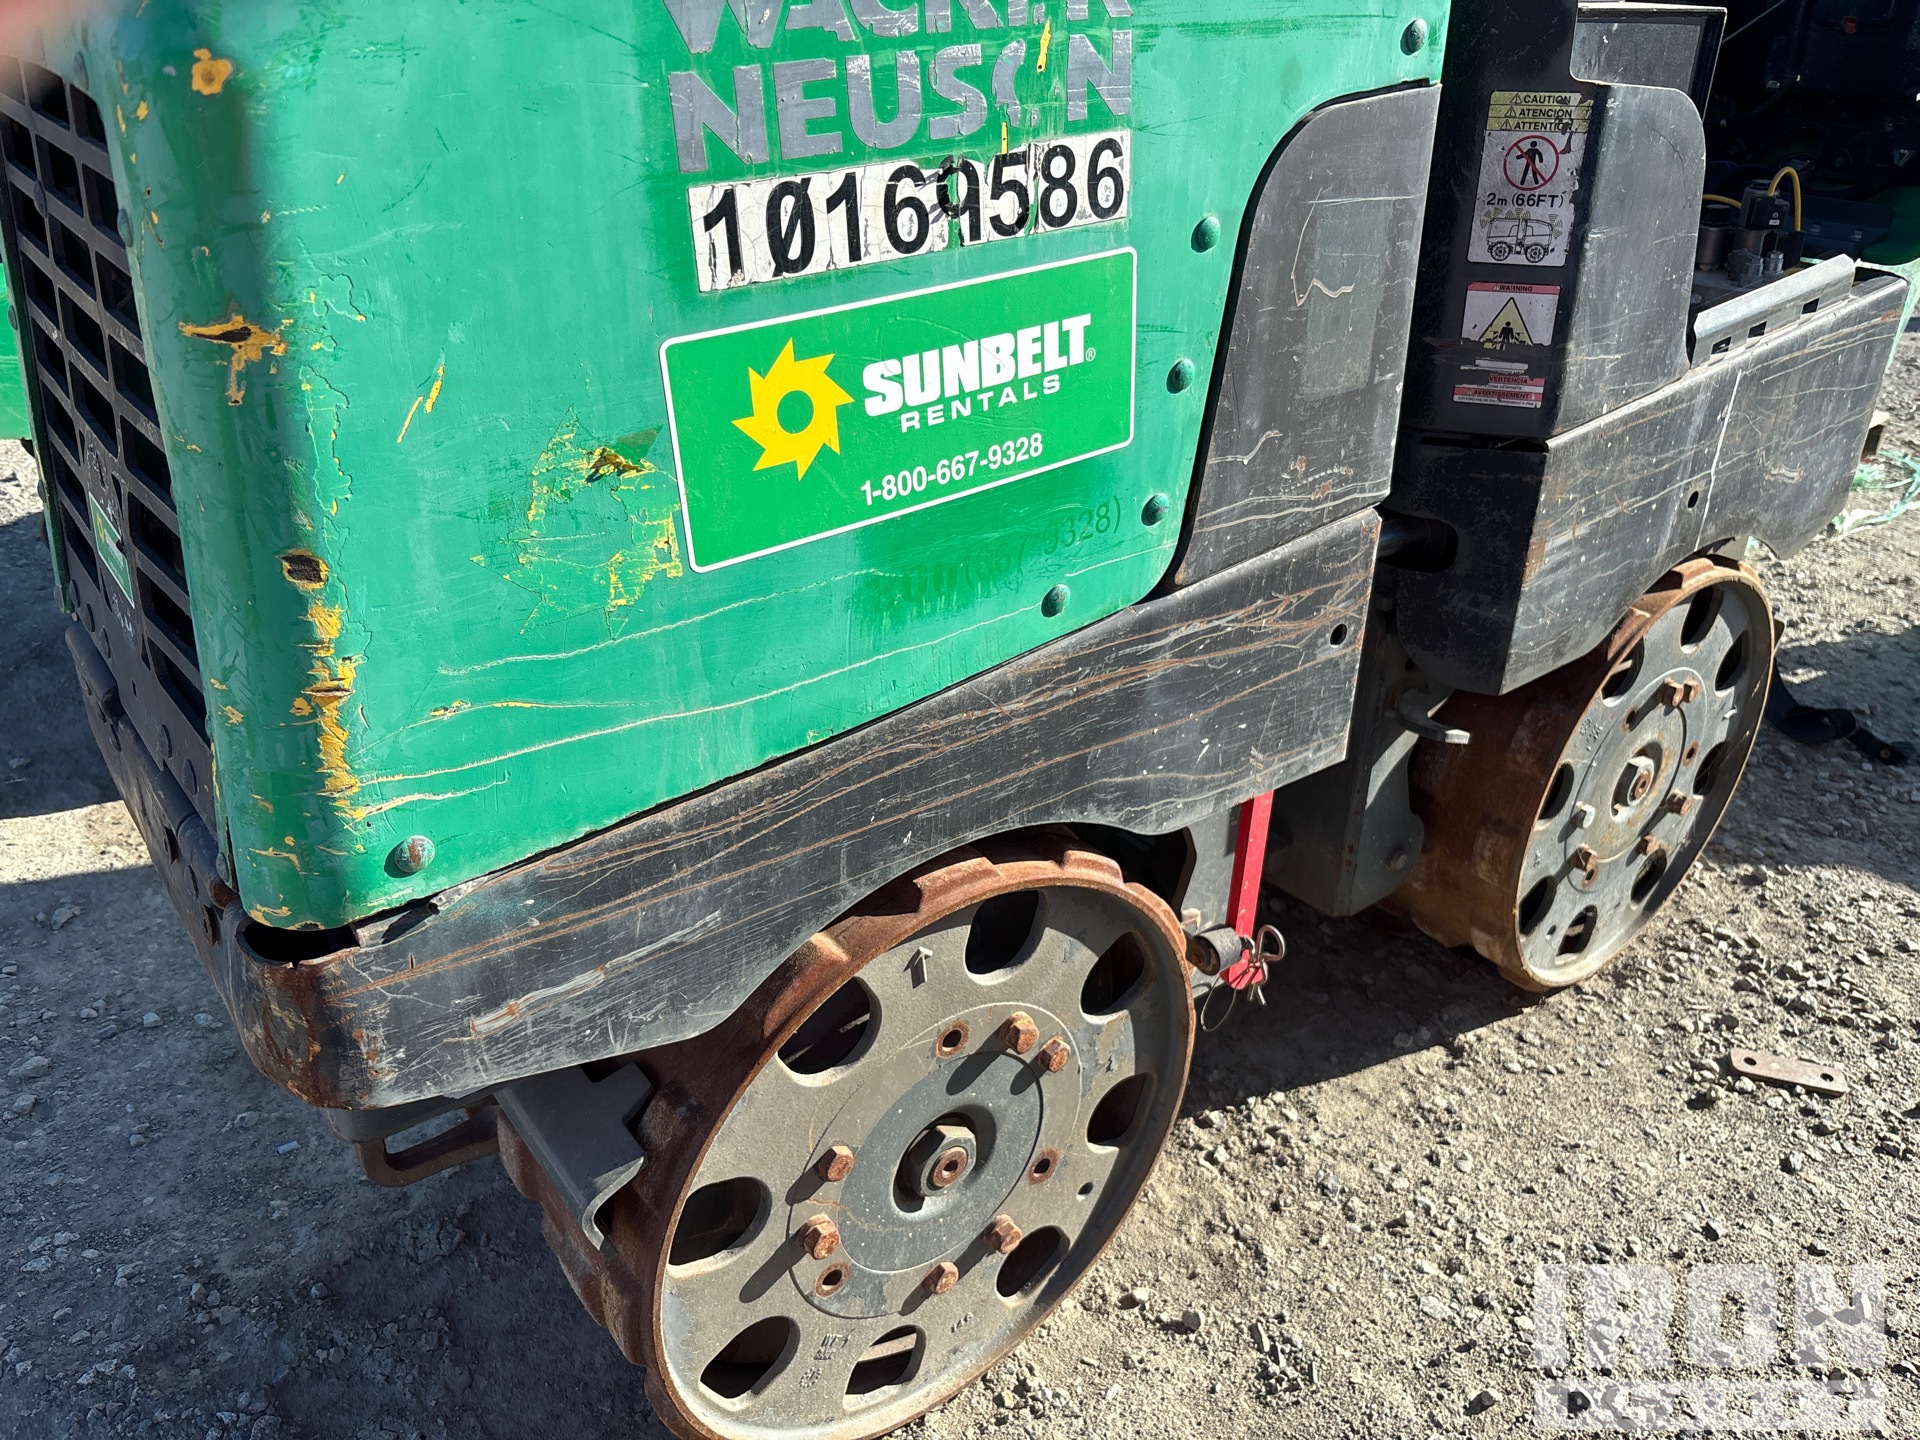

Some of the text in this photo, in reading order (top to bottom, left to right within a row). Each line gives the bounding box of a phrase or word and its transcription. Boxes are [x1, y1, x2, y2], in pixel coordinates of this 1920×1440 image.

[1523, 94, 1571, 105] CAUTION
[1518, 108, 1572, 118] ATENCION
[1486, 192, 1507, 206] 2m
[703, 137, 1125, 278] 10169586
[1473, 389, 1530, 399] AVERTISSEMENT
[900, 374, 1061, 433] RENTALS
[860, 432, 1043, 506] 1-800-667-9328
